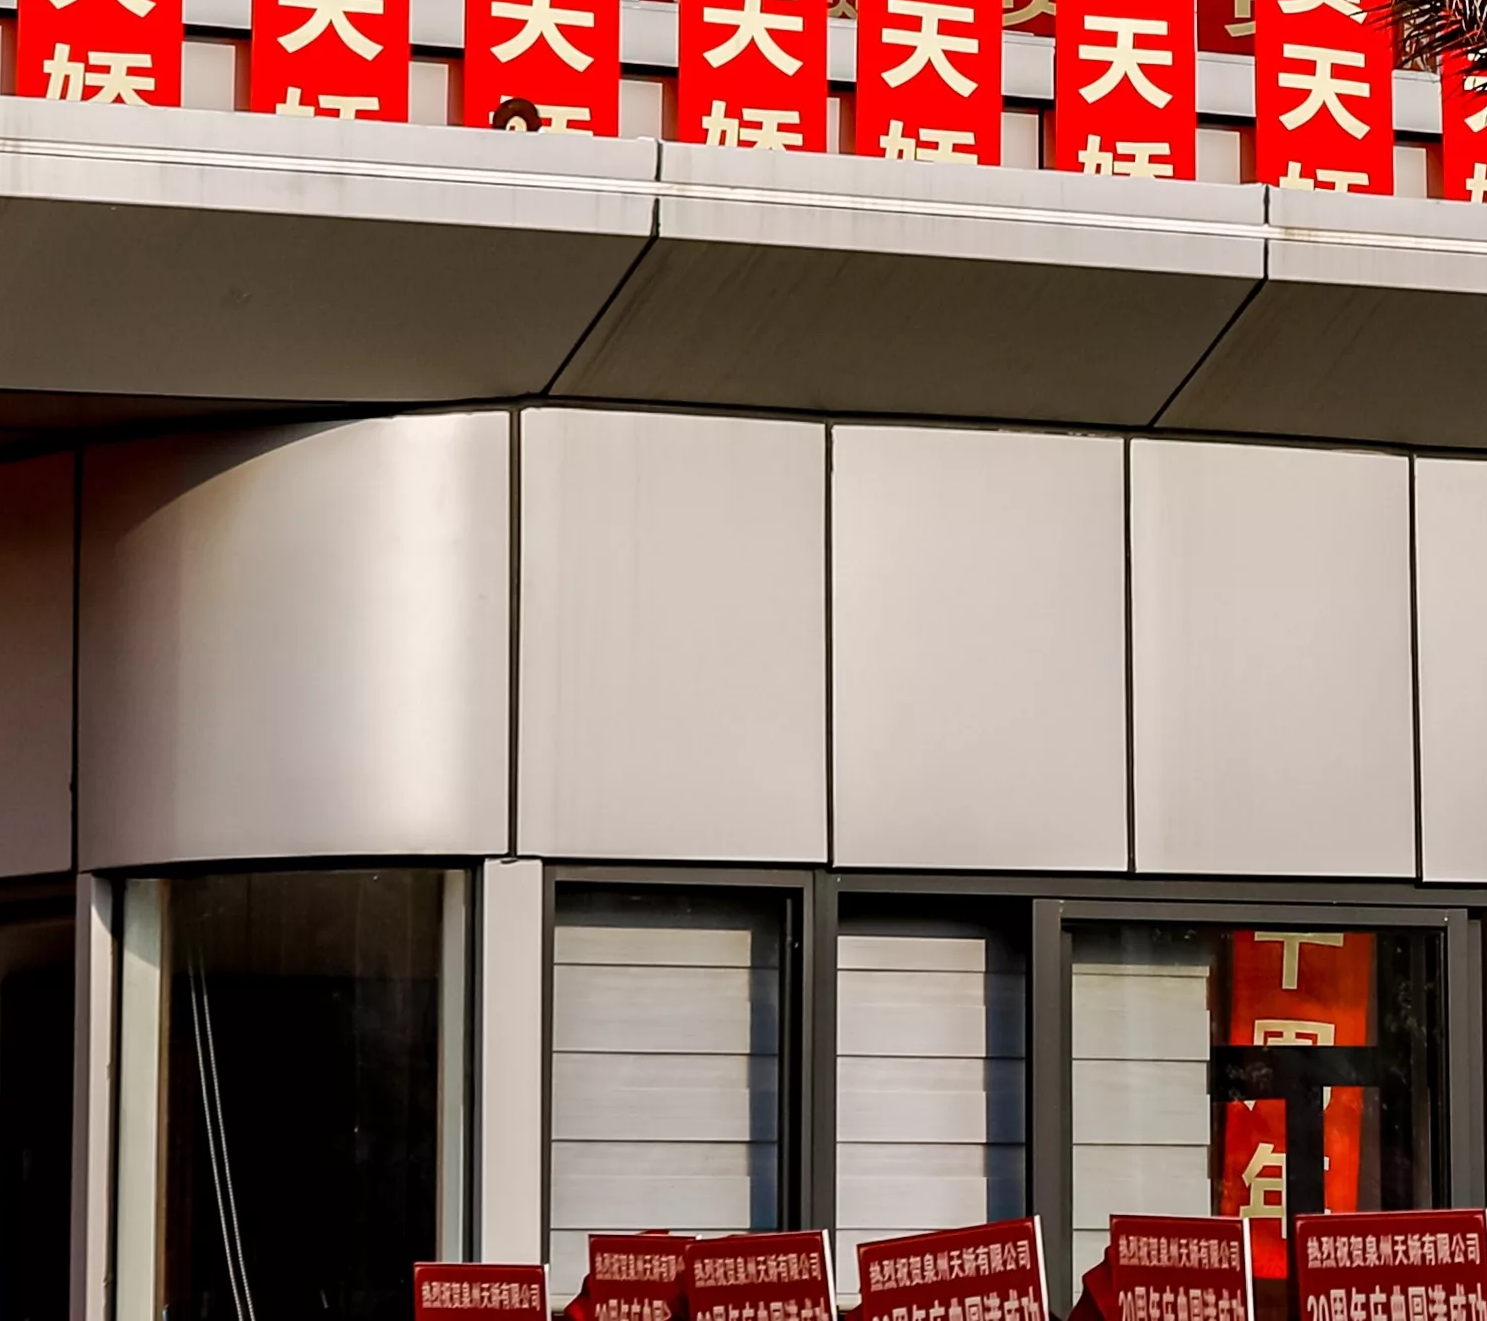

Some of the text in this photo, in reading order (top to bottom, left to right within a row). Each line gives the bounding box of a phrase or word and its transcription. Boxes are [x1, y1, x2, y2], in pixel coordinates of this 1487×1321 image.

[1306, 1232, 1481, 1269] 热烈祝贺泉州天娇有限公司
